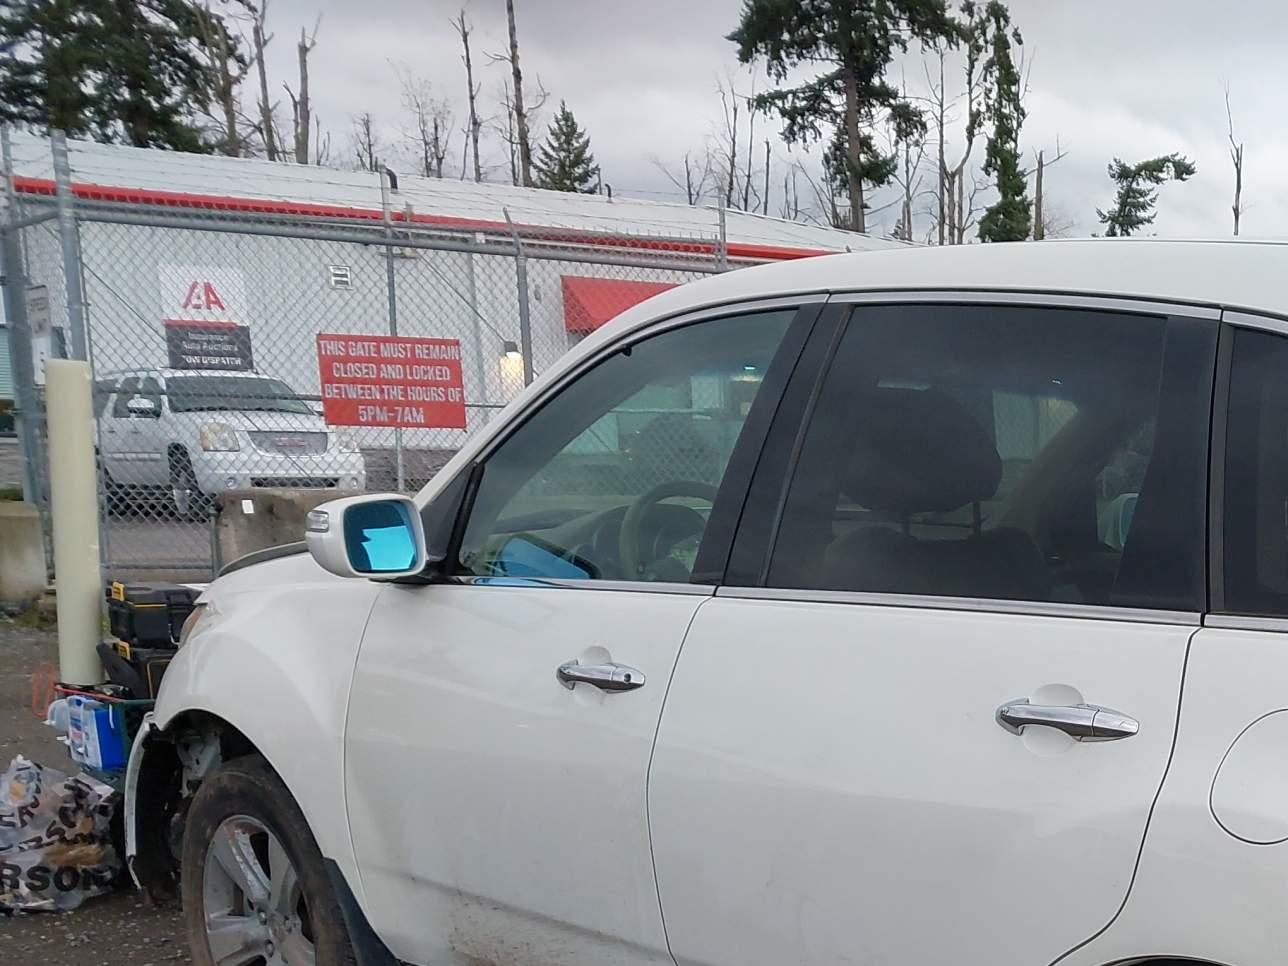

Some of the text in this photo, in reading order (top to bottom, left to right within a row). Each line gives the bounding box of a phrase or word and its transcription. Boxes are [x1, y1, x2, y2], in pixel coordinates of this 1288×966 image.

[319, 340, 460, 360] THIS GATE MUST REMAIN
[333, 362, 450, 380] CLOSED AND LOCKED
[324, 384, 462, 402] BETWEEN THE HOURS OF
[358, 405, 425, 423] 5PM-7AM
